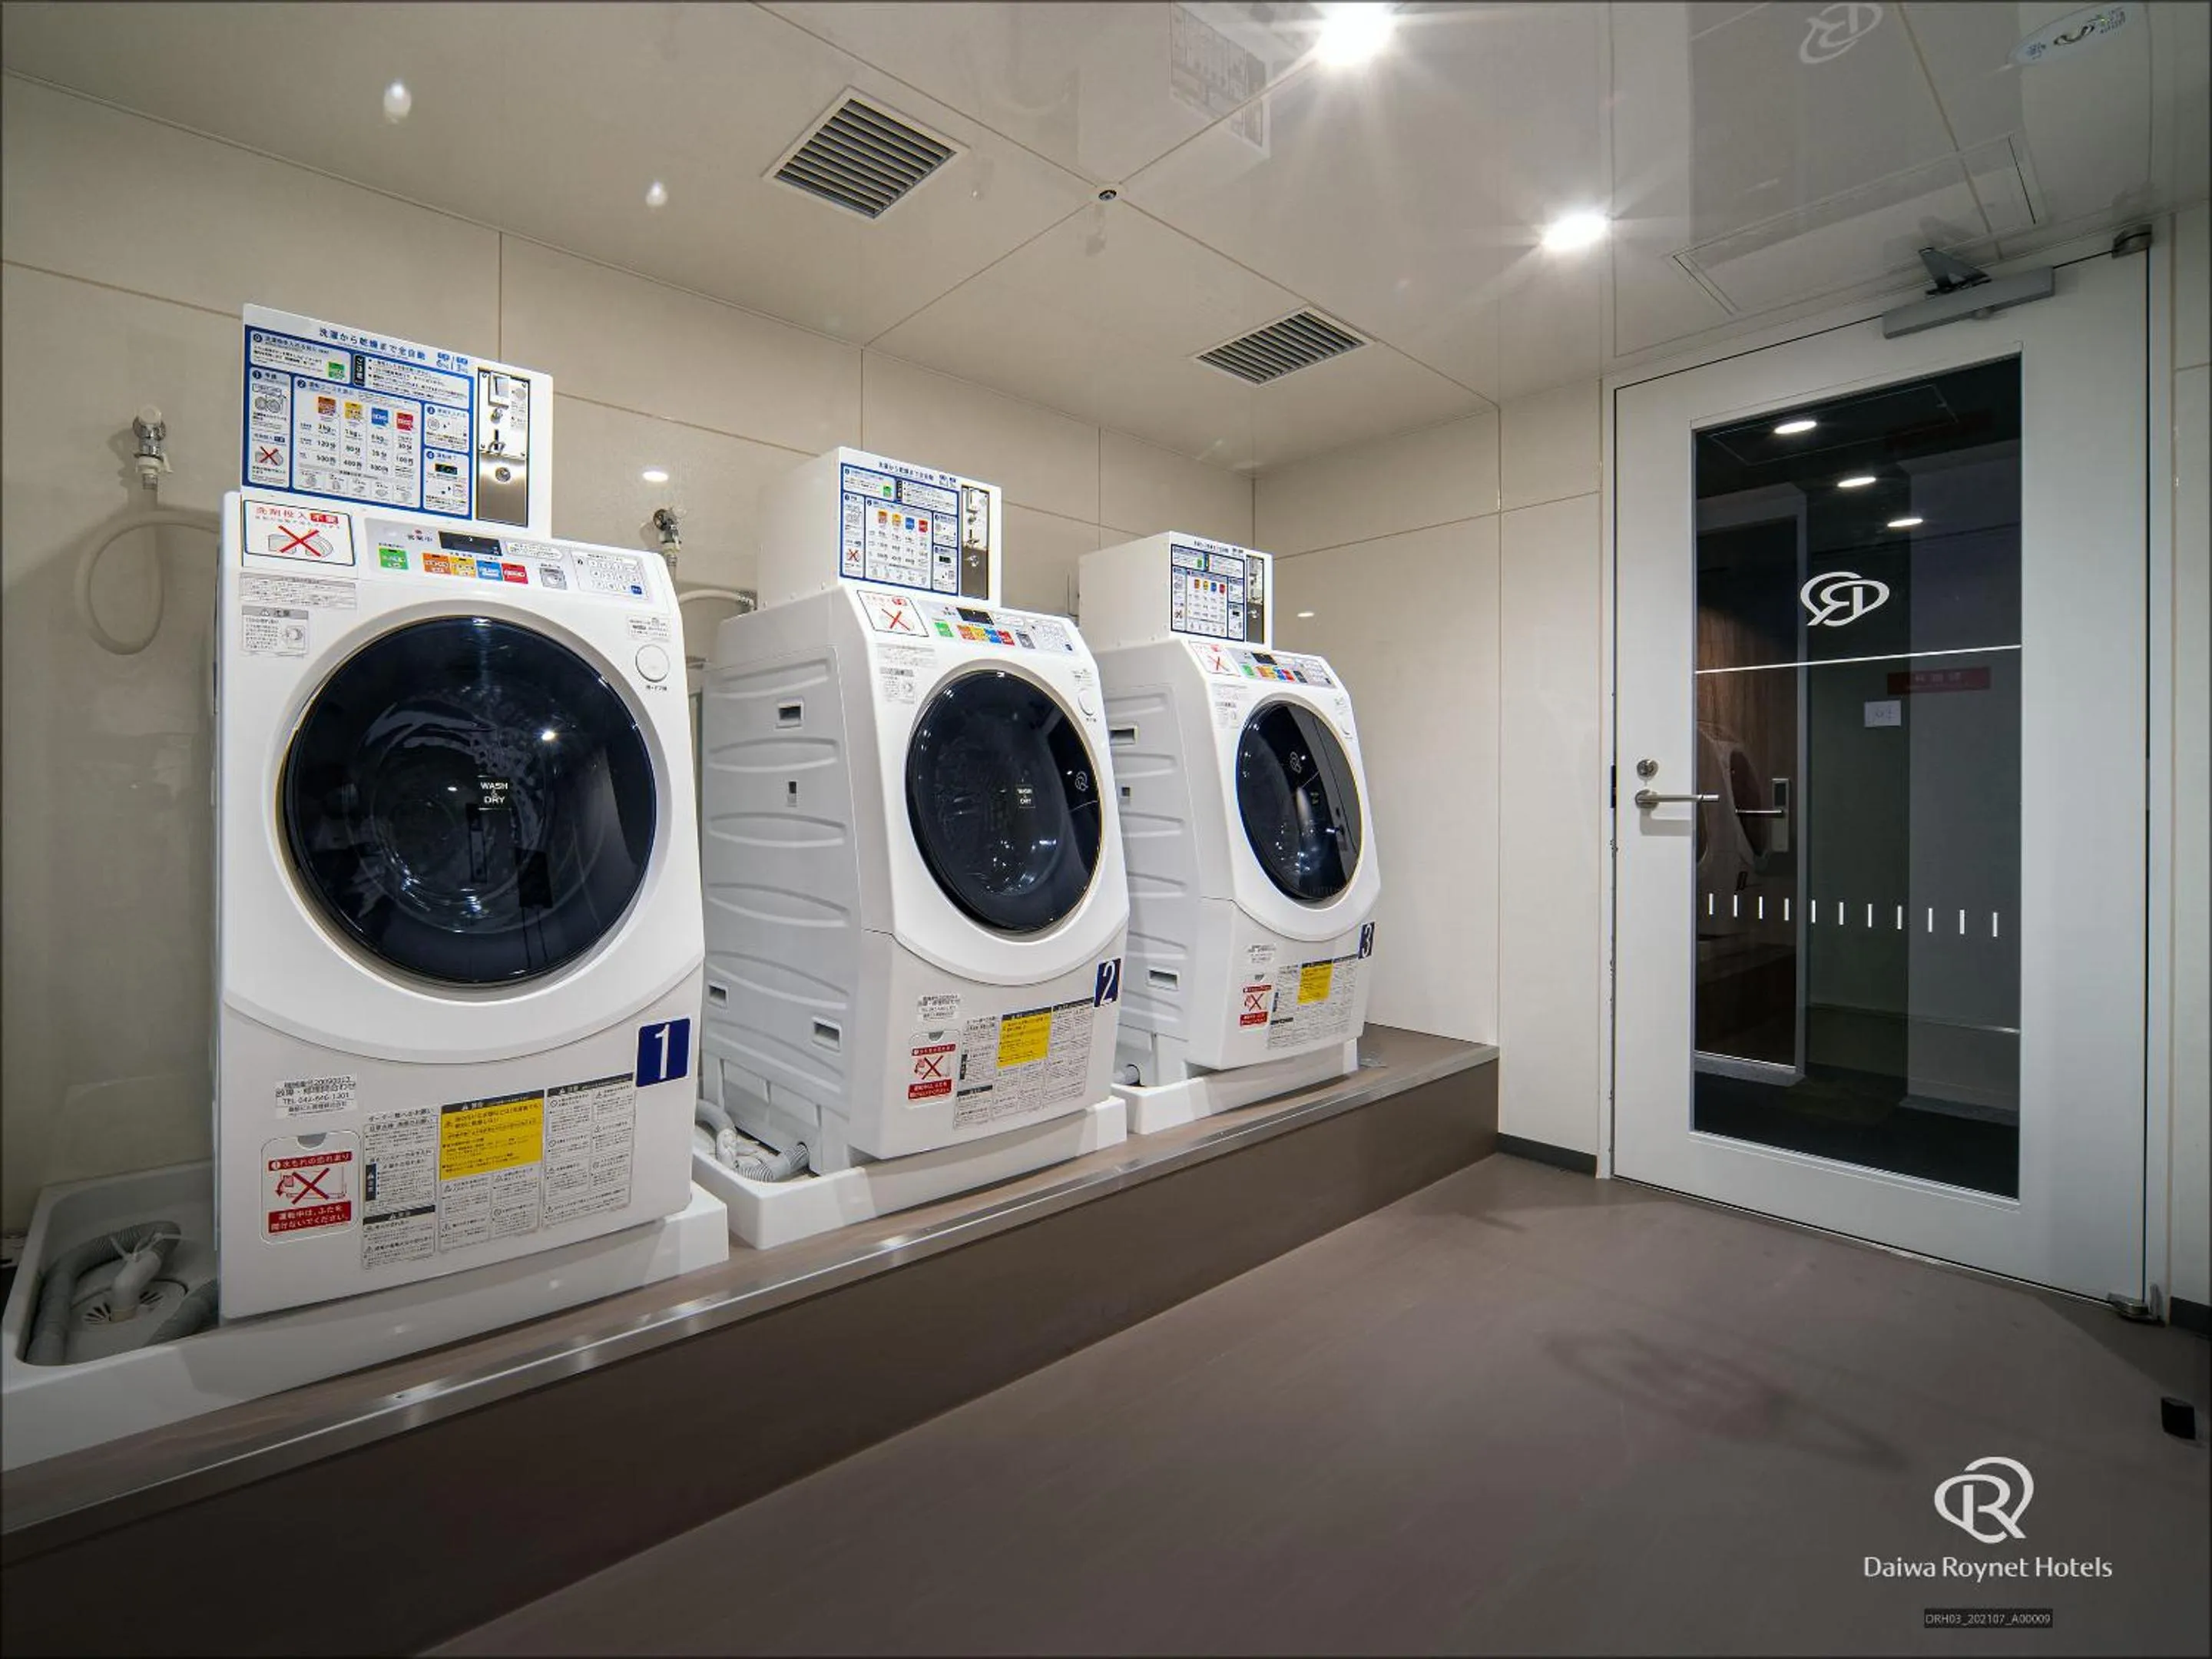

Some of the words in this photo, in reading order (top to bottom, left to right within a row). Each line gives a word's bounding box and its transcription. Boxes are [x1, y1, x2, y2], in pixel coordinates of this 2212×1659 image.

[1362, 923, 1373, 958] 3
[1100, 961, 1115, 1004] 2
[655, 1024, 671, 1079] 1
